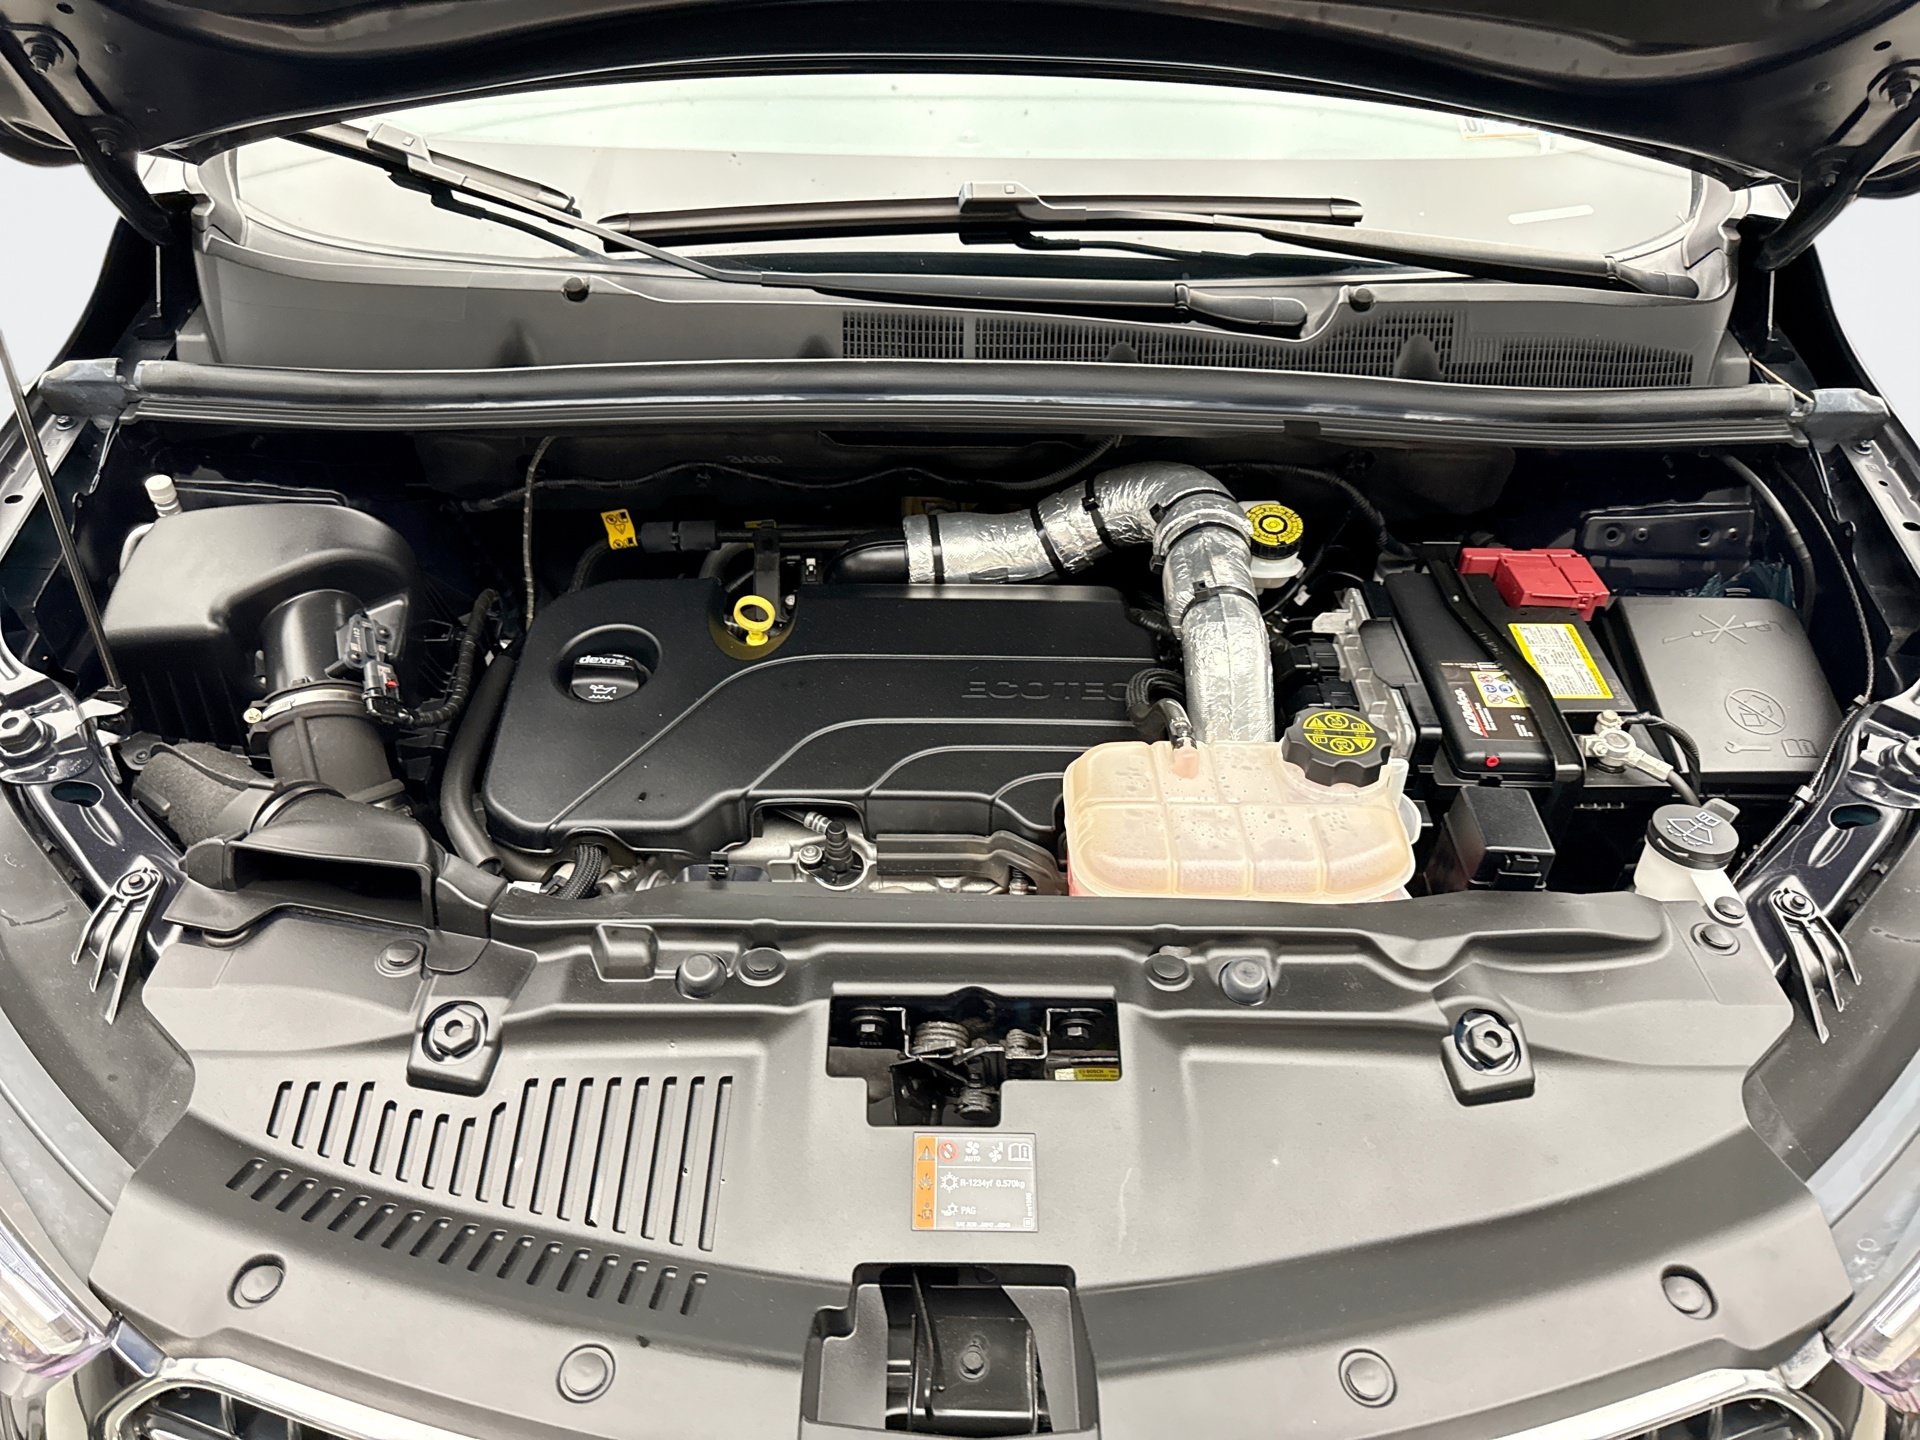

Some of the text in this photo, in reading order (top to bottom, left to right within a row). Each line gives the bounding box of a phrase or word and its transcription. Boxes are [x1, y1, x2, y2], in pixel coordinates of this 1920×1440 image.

[579, 655, 629, 666] dexos
[961, 681, 1128, 701] ECOTEC
[960, 1179, 994, 1189] R-1234yf
[960, 1206, 976, 1215] PAG
